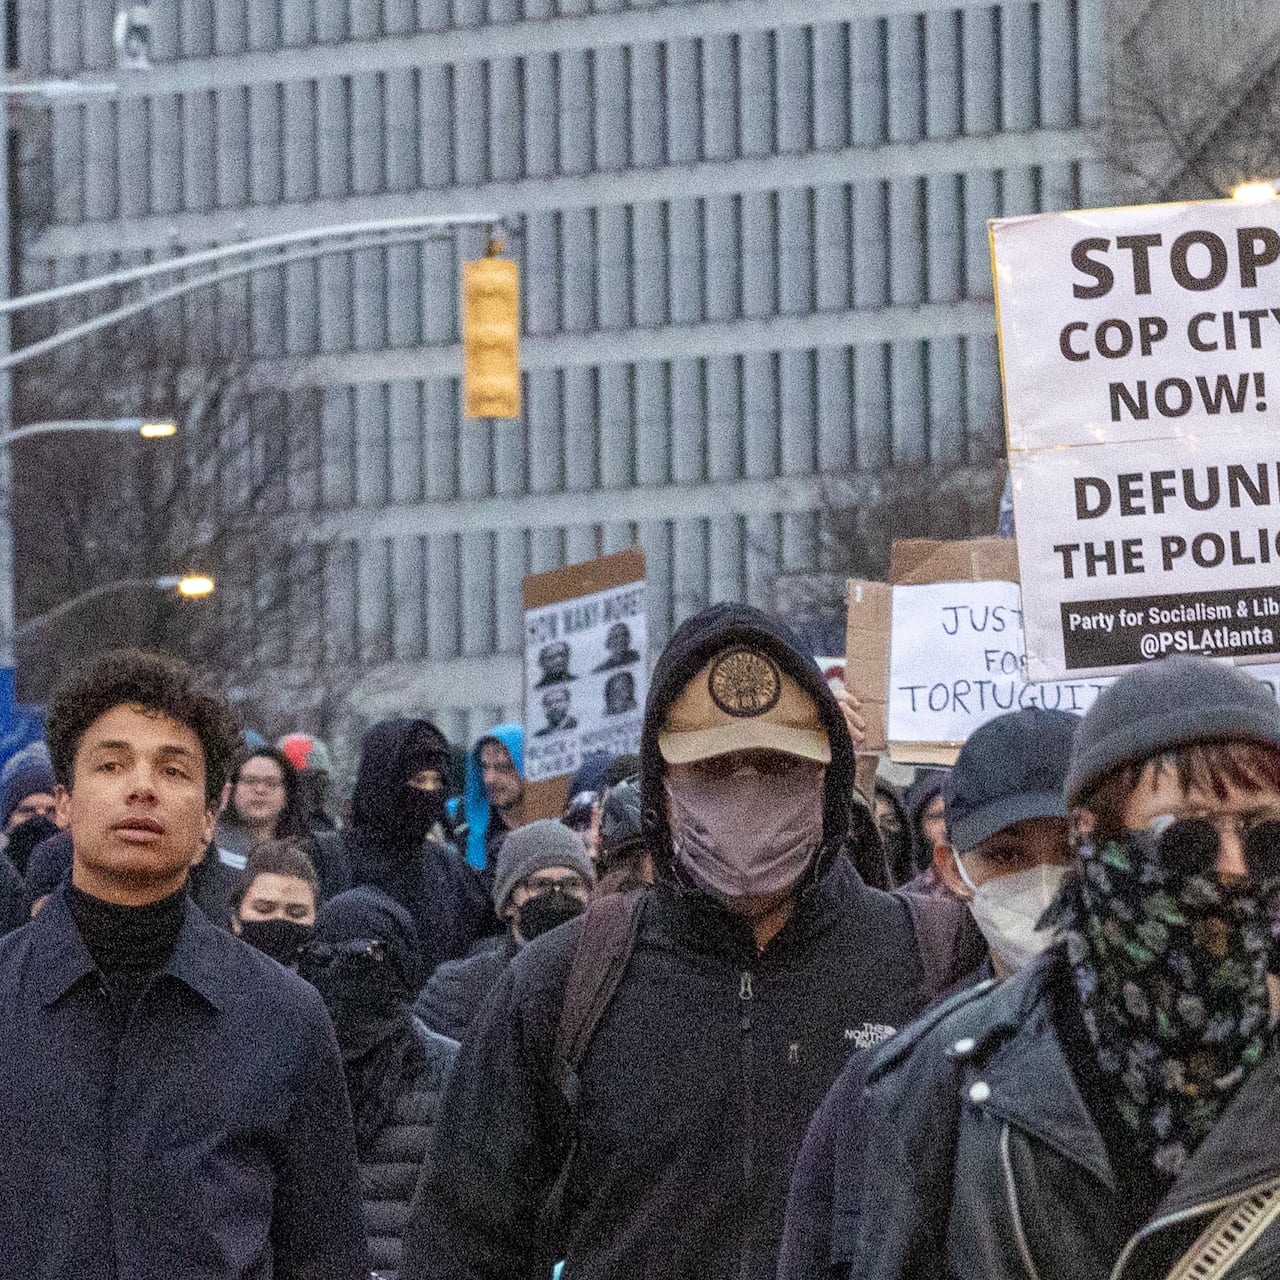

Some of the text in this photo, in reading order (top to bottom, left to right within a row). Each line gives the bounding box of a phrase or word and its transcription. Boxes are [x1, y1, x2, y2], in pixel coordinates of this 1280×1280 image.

[1059, 315, 1169, 362] COP
[1109, 372, 1267, 423] NOW!
[1053, 539, 1144, 580] THE
[1069, 612, 1114, 632] Party
[1120, 609, 1143, 626] for
[1150, 600, 1229, 626] Socialism
[1236, 599, 1247, 616] &
[1141, 624, 1273, 656] @PSLAtlanta
